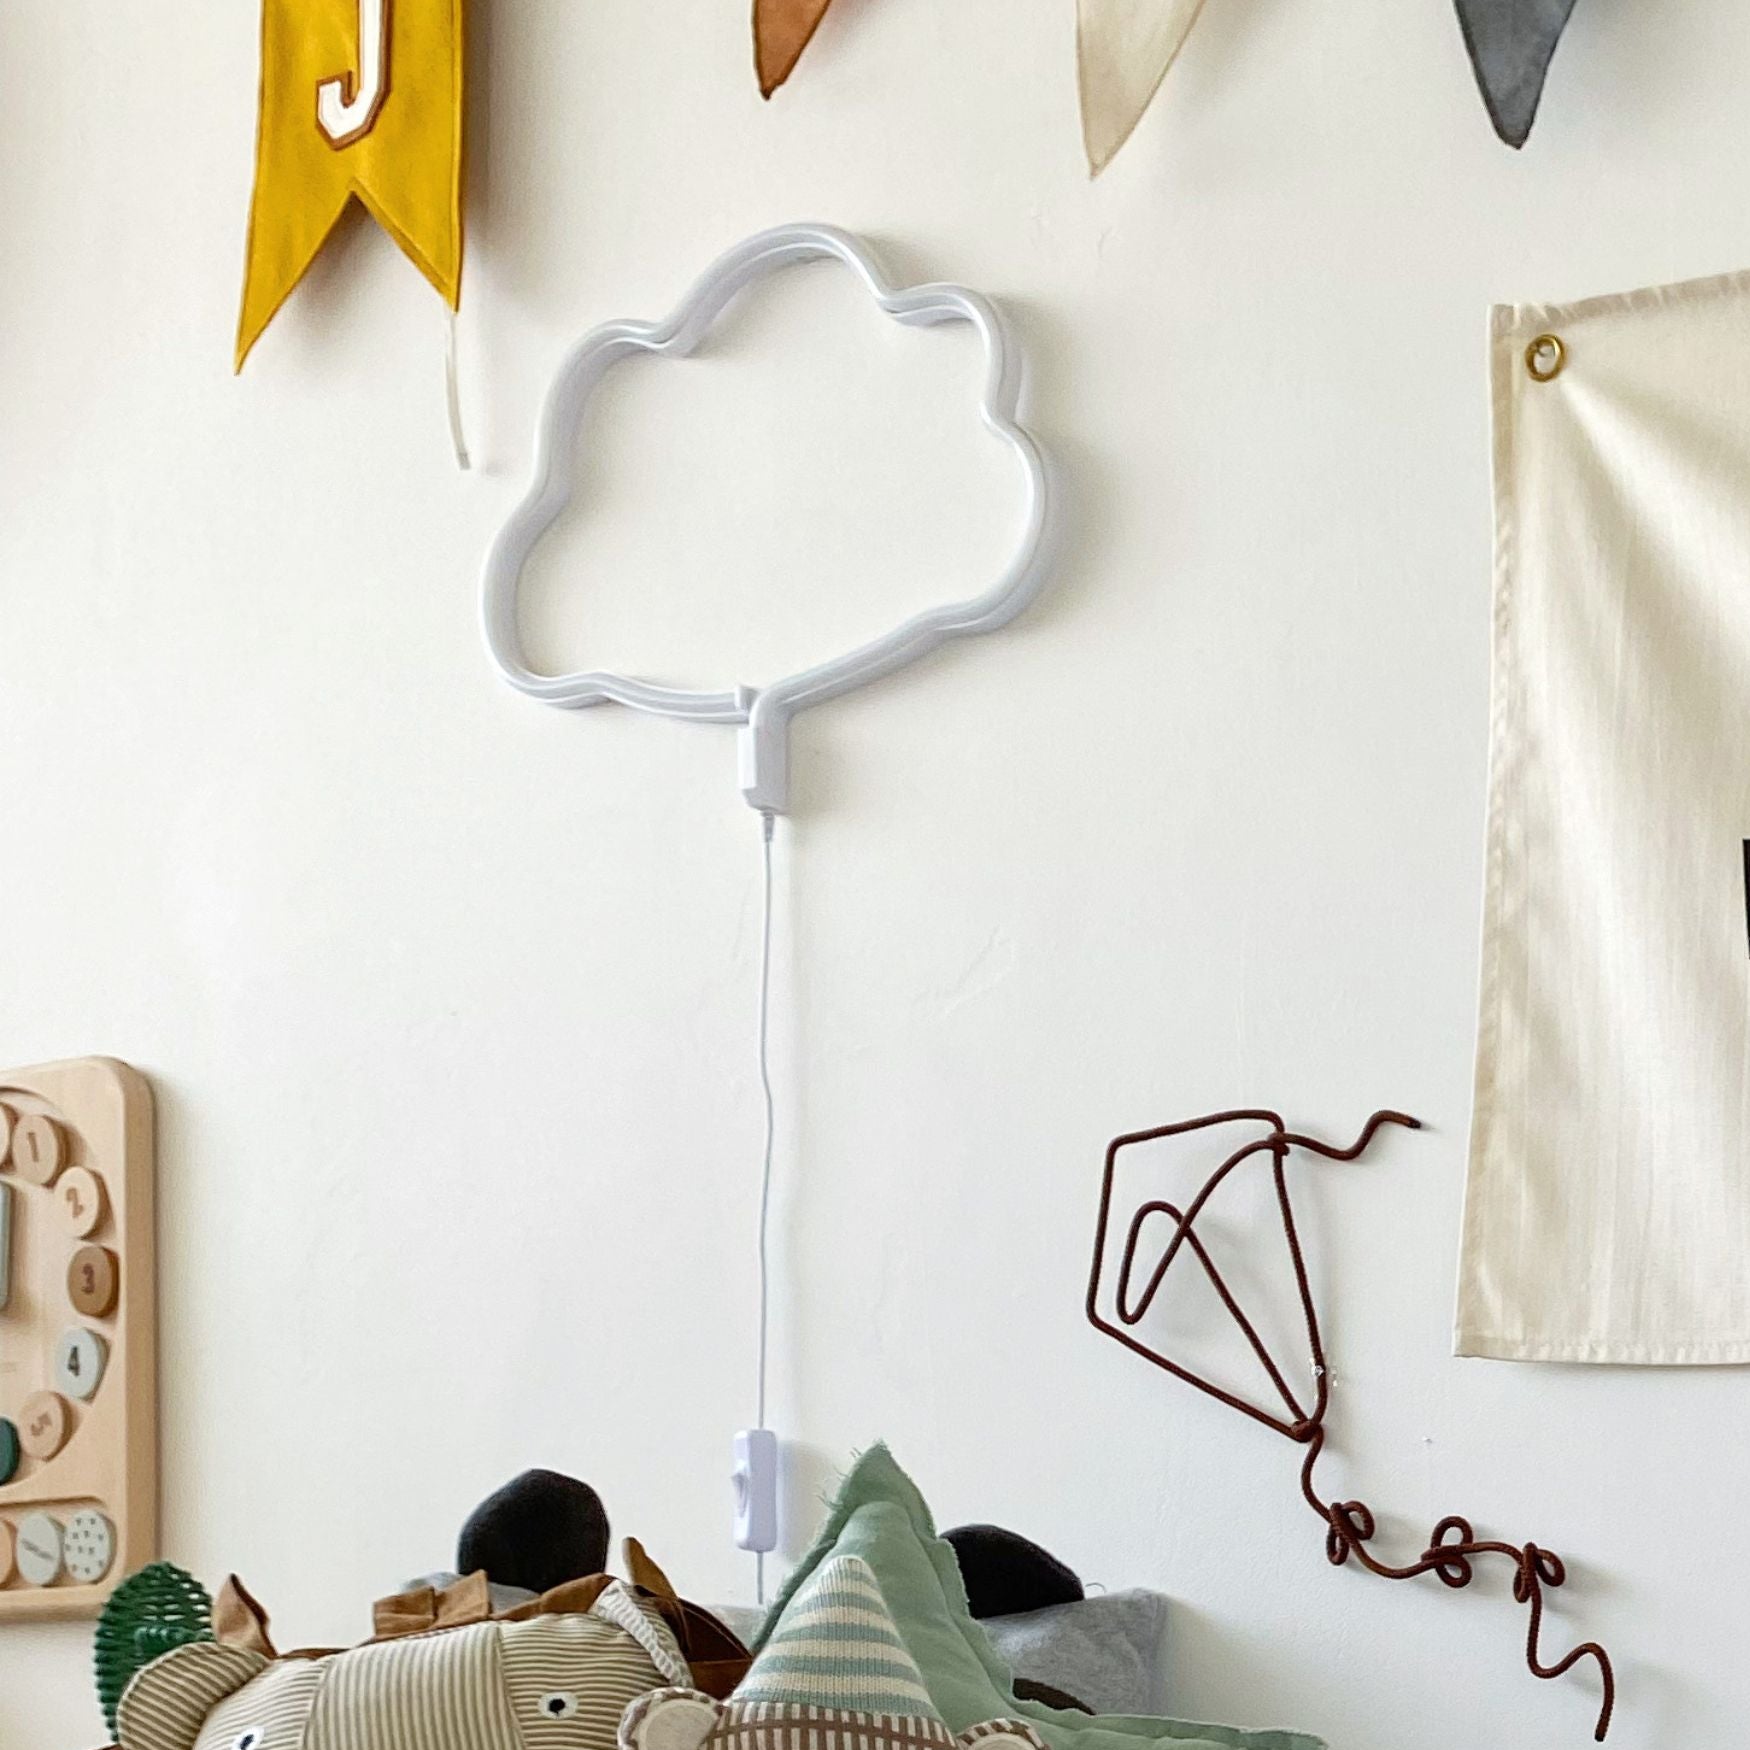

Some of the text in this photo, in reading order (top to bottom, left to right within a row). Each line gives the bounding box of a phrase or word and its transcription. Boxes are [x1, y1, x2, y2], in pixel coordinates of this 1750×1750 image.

[26, 1131, 40, 1163] 1
[65, 1187, 85, 1219] 2
[81, 1262, 96, 1295] 3
[67, 1345, 81, 1377] 4
[30, 1411, 53, 1436] 5
